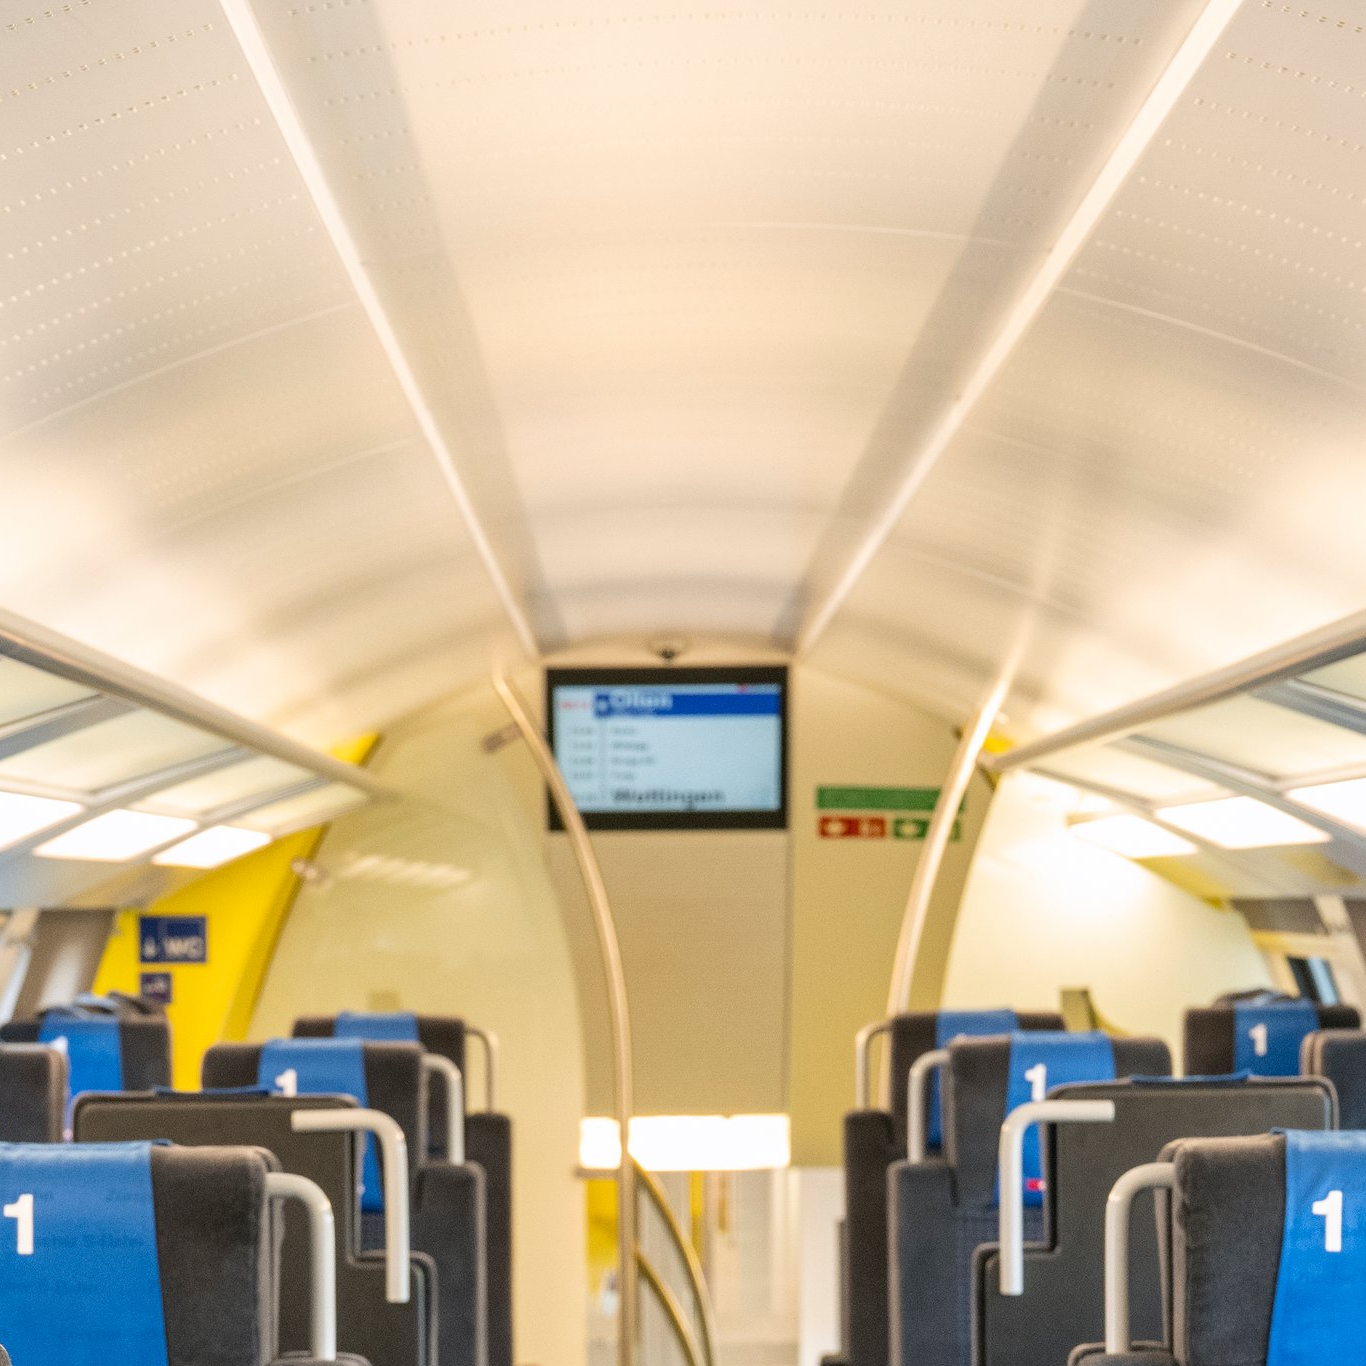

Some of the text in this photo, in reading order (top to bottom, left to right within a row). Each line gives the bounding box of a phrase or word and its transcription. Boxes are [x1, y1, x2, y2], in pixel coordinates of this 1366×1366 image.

[1248, 1023, 1268, 1056] 1
[1023, 1063, 1046, 1101] 1
[2, 1193, 34, 1255] 1
[1311, 1190, 1343, 1252] 1
